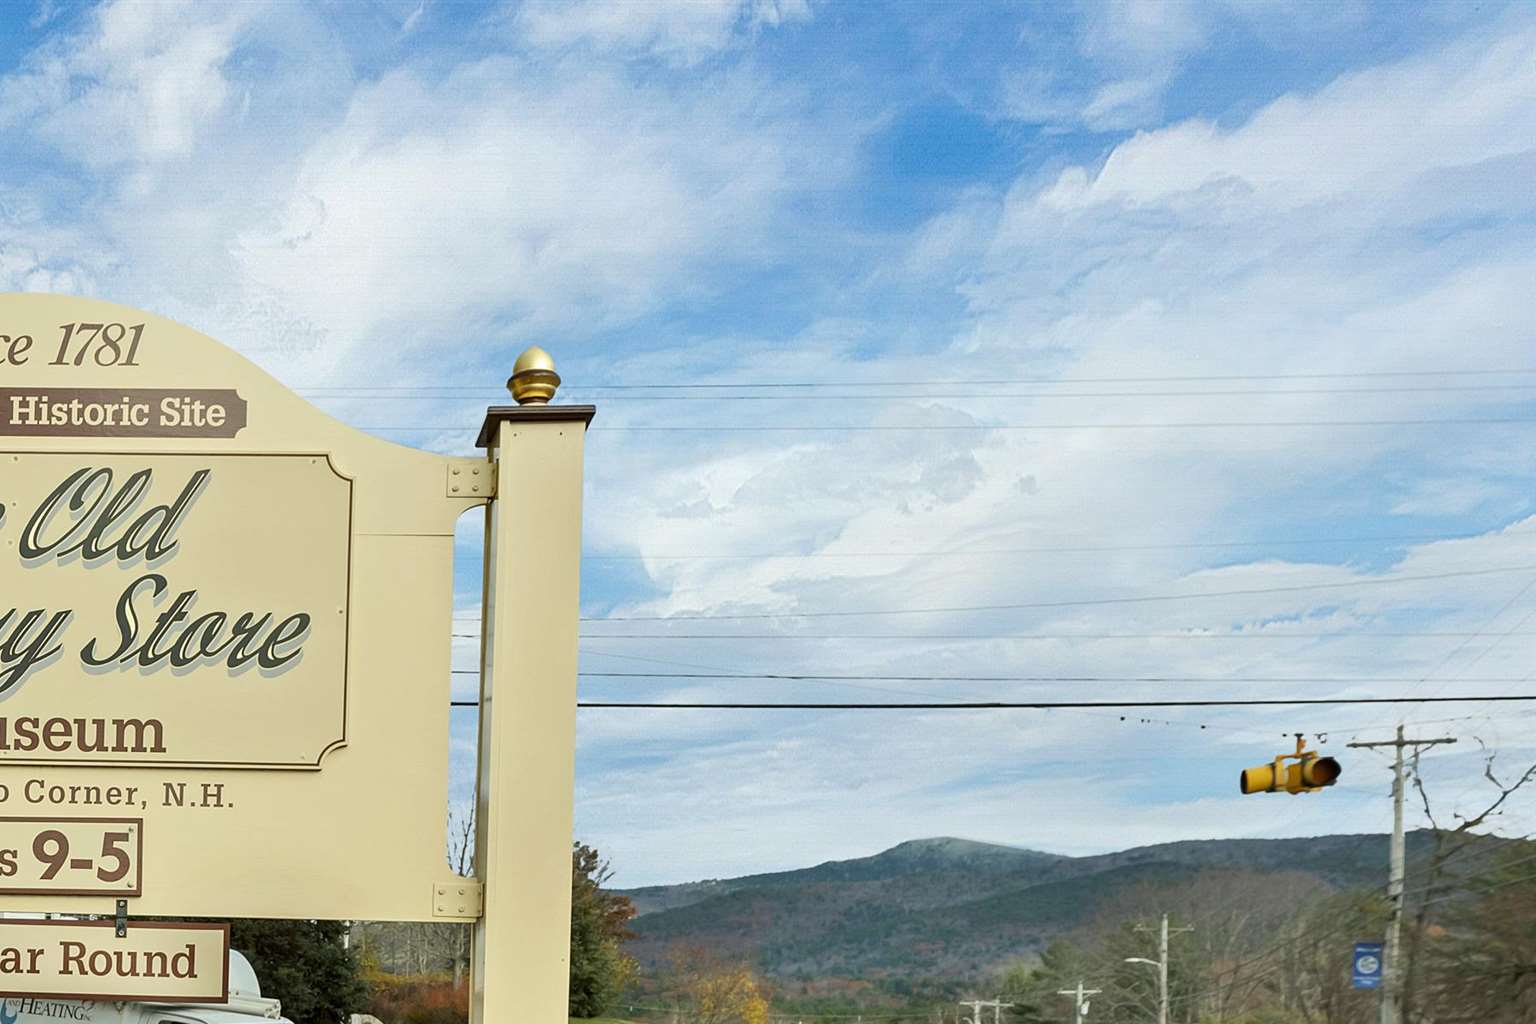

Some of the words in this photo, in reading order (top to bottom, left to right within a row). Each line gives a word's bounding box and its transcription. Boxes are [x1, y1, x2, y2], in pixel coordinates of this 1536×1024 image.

[47, 322, 145, 368] 1781
[9, 395, 150, 428] Historic
[159, 396, 226, 428] Site
[18, 466, 212, 564] Old
[79, 573, 313, 672] Store
[24, 779, 148, 811] Corner,
[162, 782, 235, 809] N.H.
[31, 829, 131, 883] 9-5
[58, 941, 199, 980] Round
[18, 996, 85, 1021] HEATING
